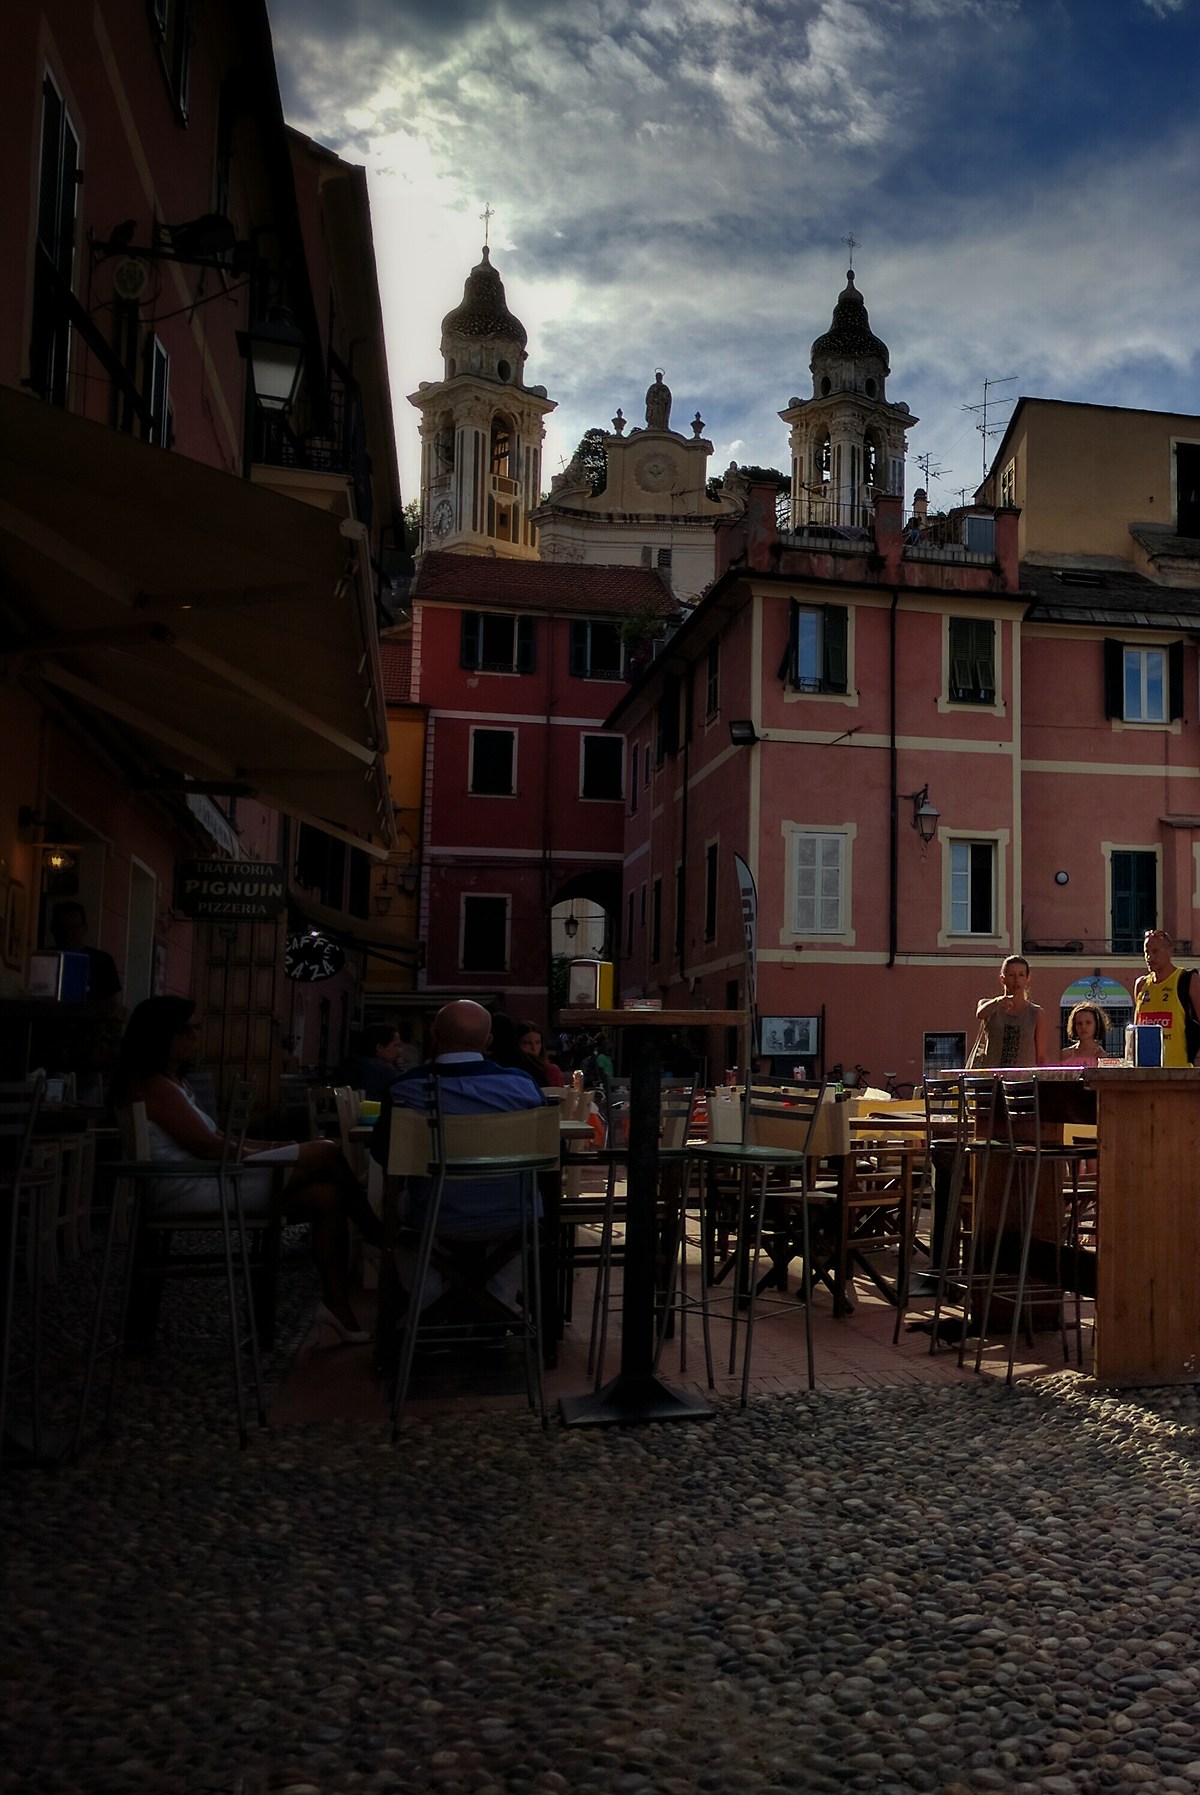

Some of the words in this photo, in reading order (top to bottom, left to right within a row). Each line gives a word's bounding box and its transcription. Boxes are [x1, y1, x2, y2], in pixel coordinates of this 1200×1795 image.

[195, 862, 274, 876] TRATTORIA
[184, 879, 283, 897] PIGNUIN
[197, 902, 268, 914] PIZZERIA
